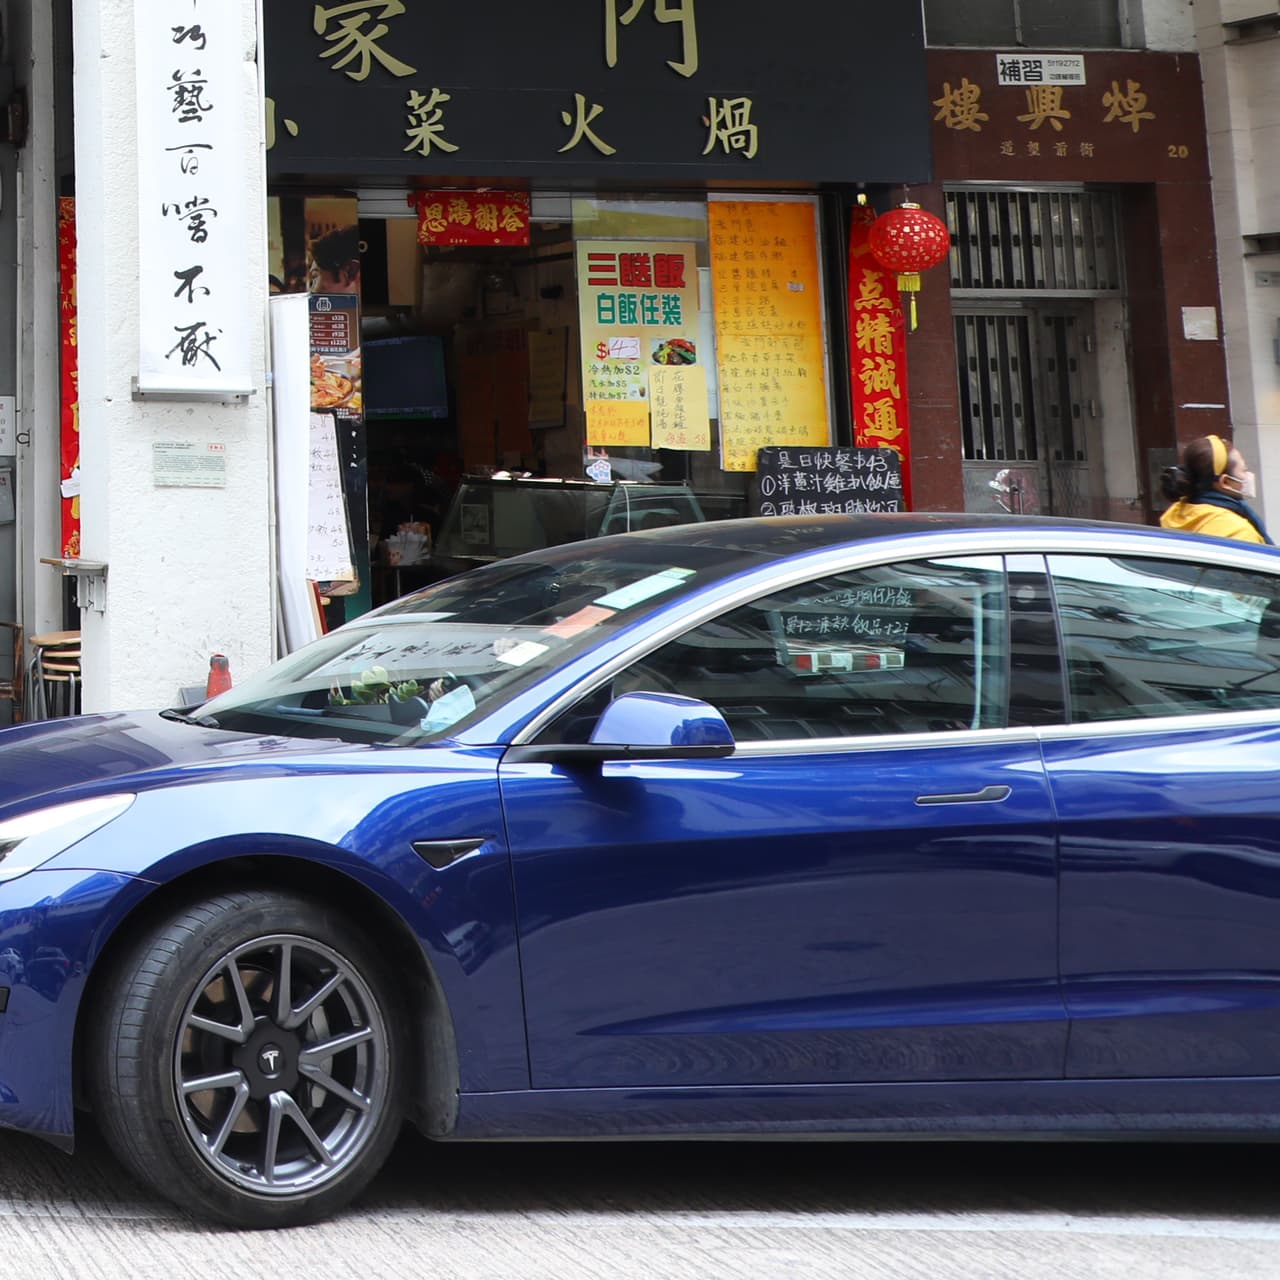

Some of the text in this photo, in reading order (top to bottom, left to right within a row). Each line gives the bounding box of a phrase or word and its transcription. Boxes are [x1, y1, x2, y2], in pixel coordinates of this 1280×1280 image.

[999, 59, 1043, 82] 補習
[1167, 144, 1189, 159] 20
[597, 292, 682, 326] 白飯任裝
